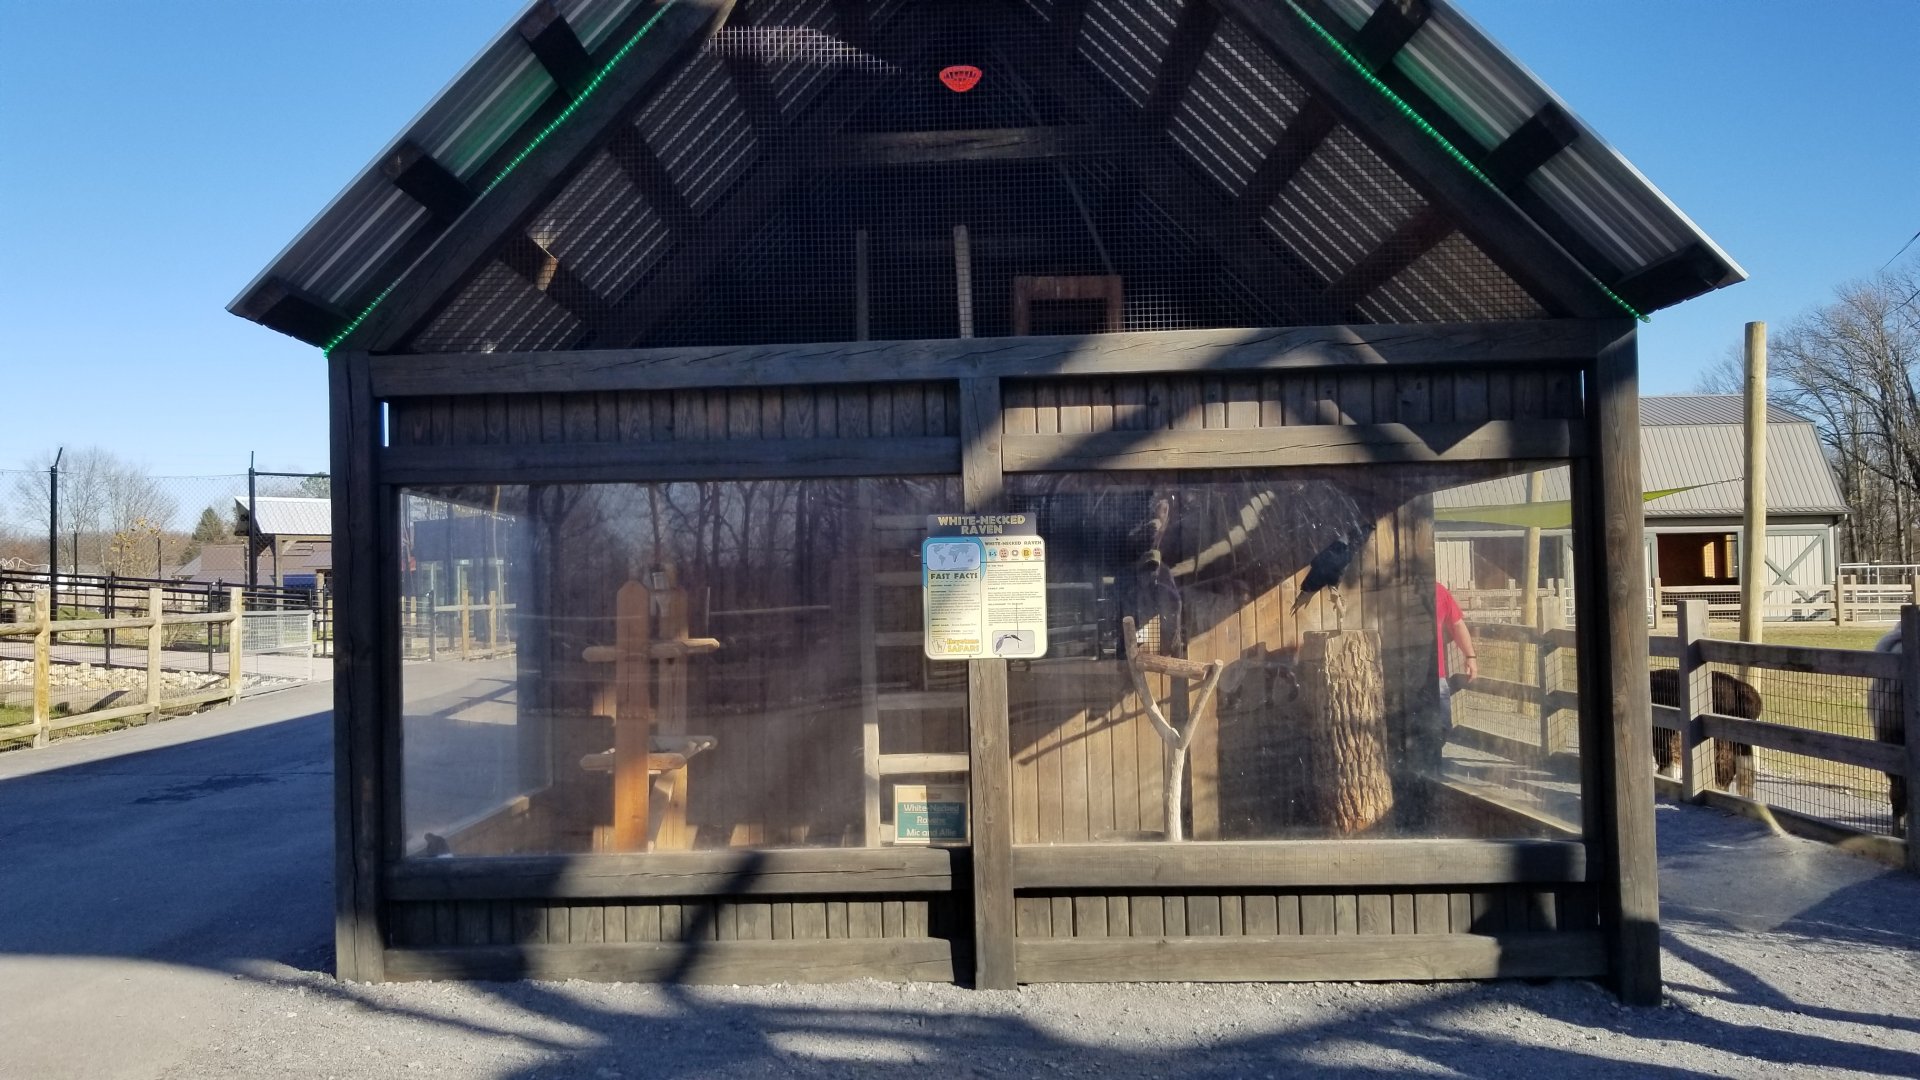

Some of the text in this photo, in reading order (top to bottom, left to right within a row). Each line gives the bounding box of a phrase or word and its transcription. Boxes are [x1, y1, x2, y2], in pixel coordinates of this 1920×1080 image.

[937, 515, 1026, 526] WHITE-NECKED
[961, 525, 1003, 535] RAVEN
[921, 828, 937, 837] and
